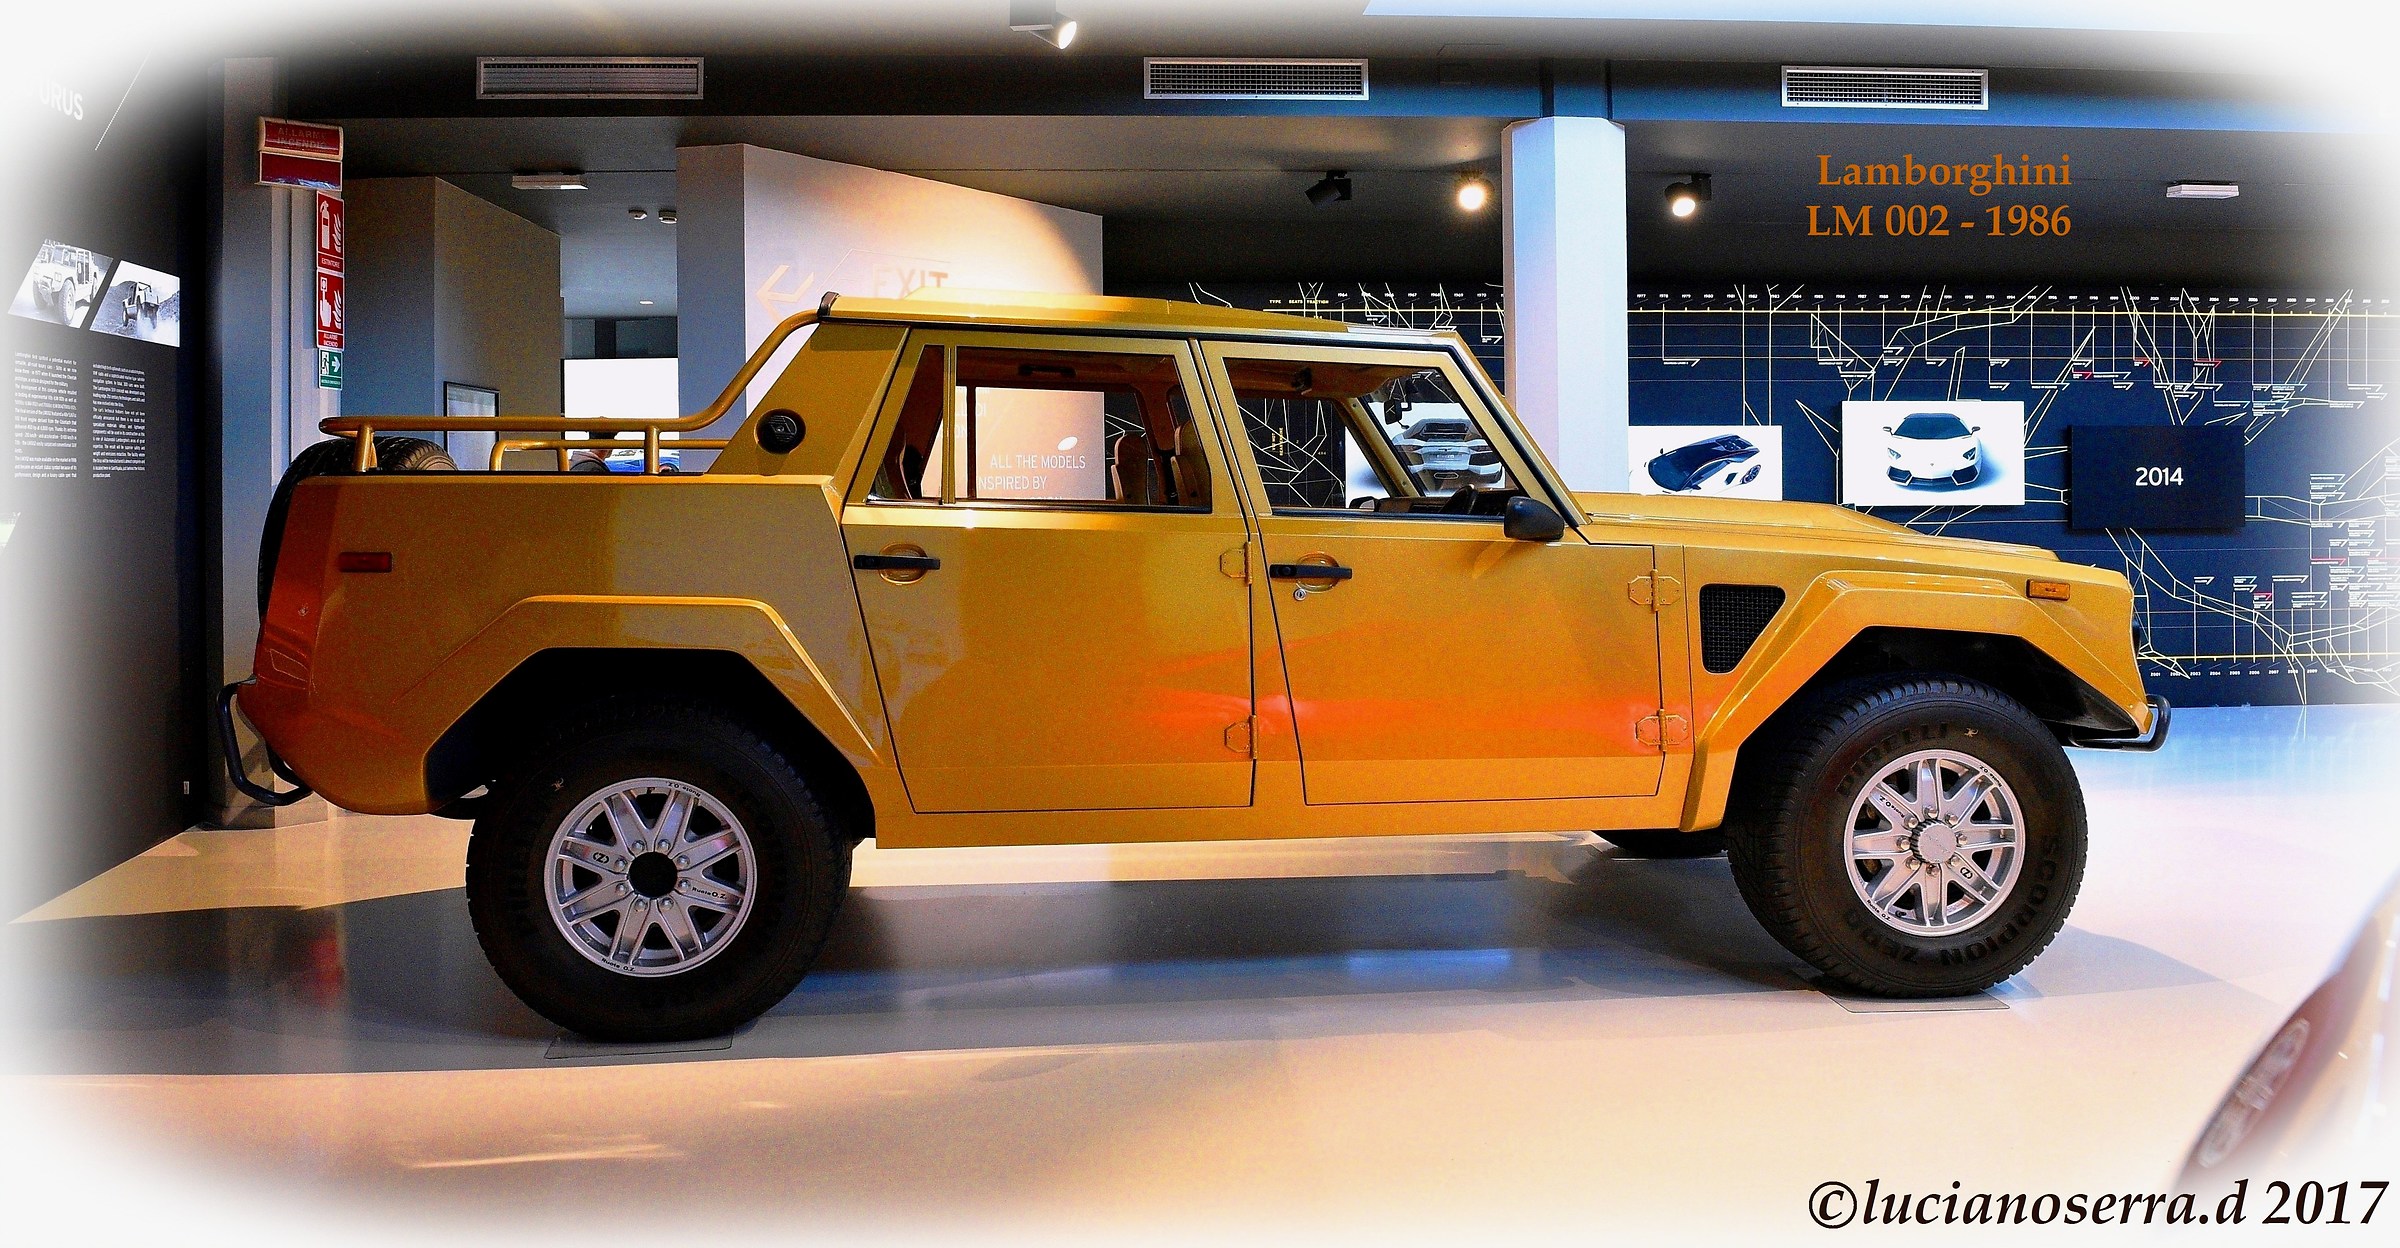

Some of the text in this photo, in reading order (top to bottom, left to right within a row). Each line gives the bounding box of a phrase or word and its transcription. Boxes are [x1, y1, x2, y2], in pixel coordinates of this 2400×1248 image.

[321, 257, 341, 269] ESTINTORE
[990, 454, 1086, 469] ALL THE MODELS
[978, 476, 1048, 490] NSPIRED BY
[2135, 467, 2184, 486] 2014
